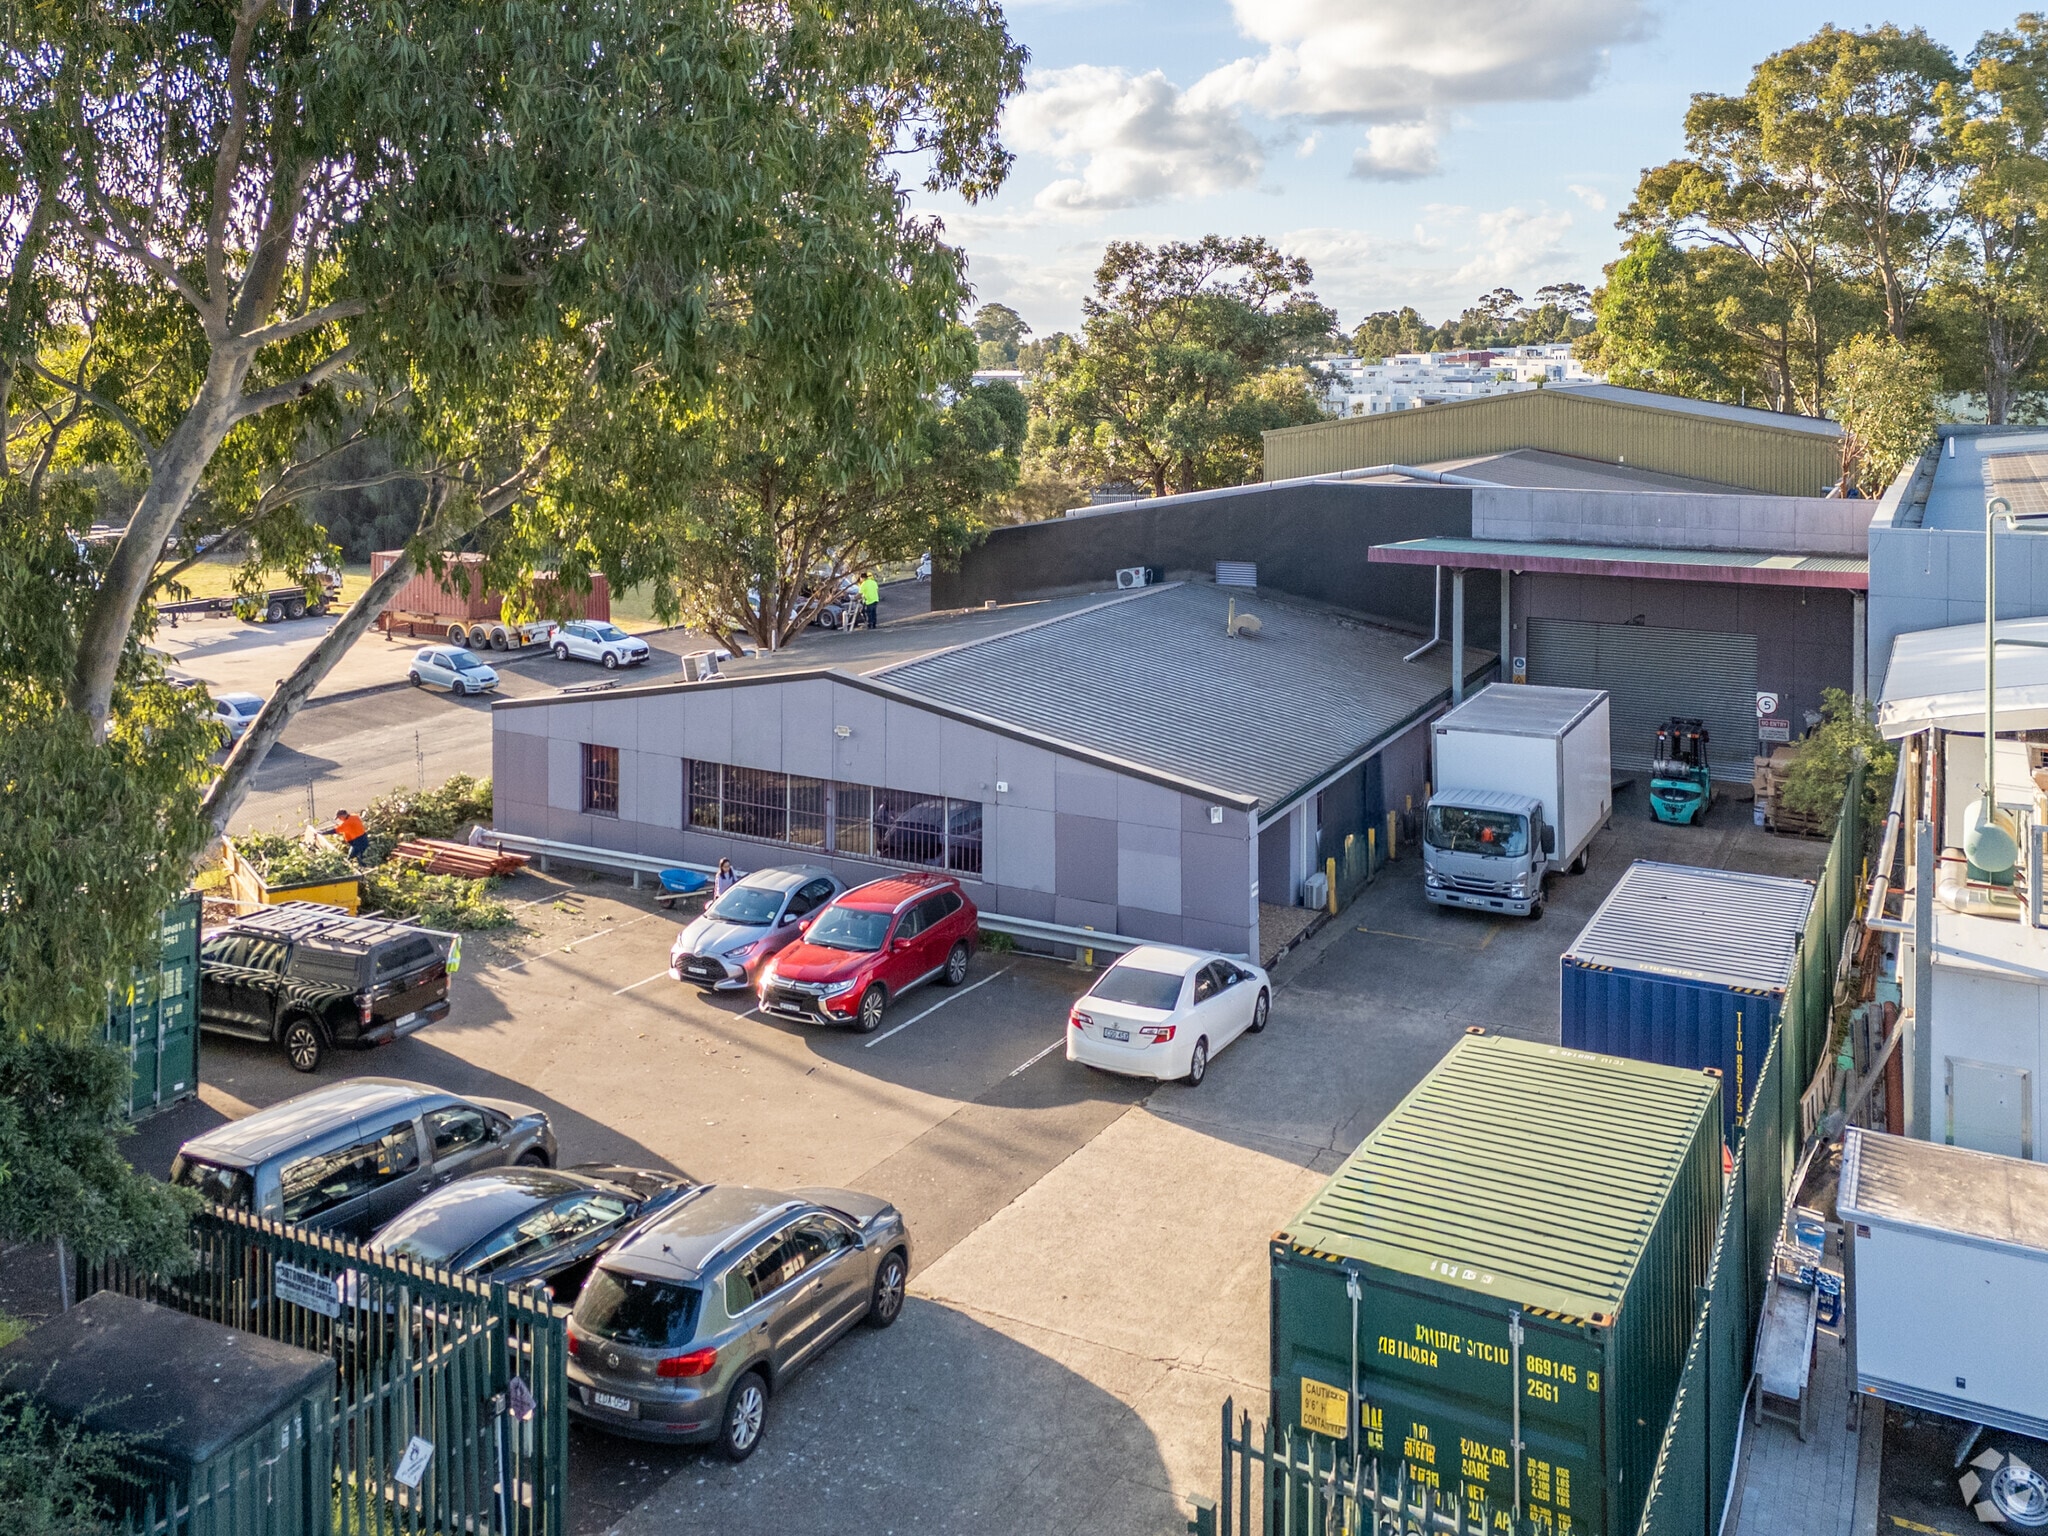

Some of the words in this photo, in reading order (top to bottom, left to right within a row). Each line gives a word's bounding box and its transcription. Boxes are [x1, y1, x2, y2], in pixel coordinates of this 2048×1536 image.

[1764, 701, 1771, 710] 5
[1526, 1354, 1577, 1384] 869145
[1588, 1372, 1598, 1391] 3
[1527, 1378, 1558, 1403] 25G1
[1556, 1466, 1570, 1479] KGS
[1556, 1476, 1570, 1489] LBS
[1556, 1486, 1570, 1499] KGS
[1556, 1496, 1570, 1509] LBS
